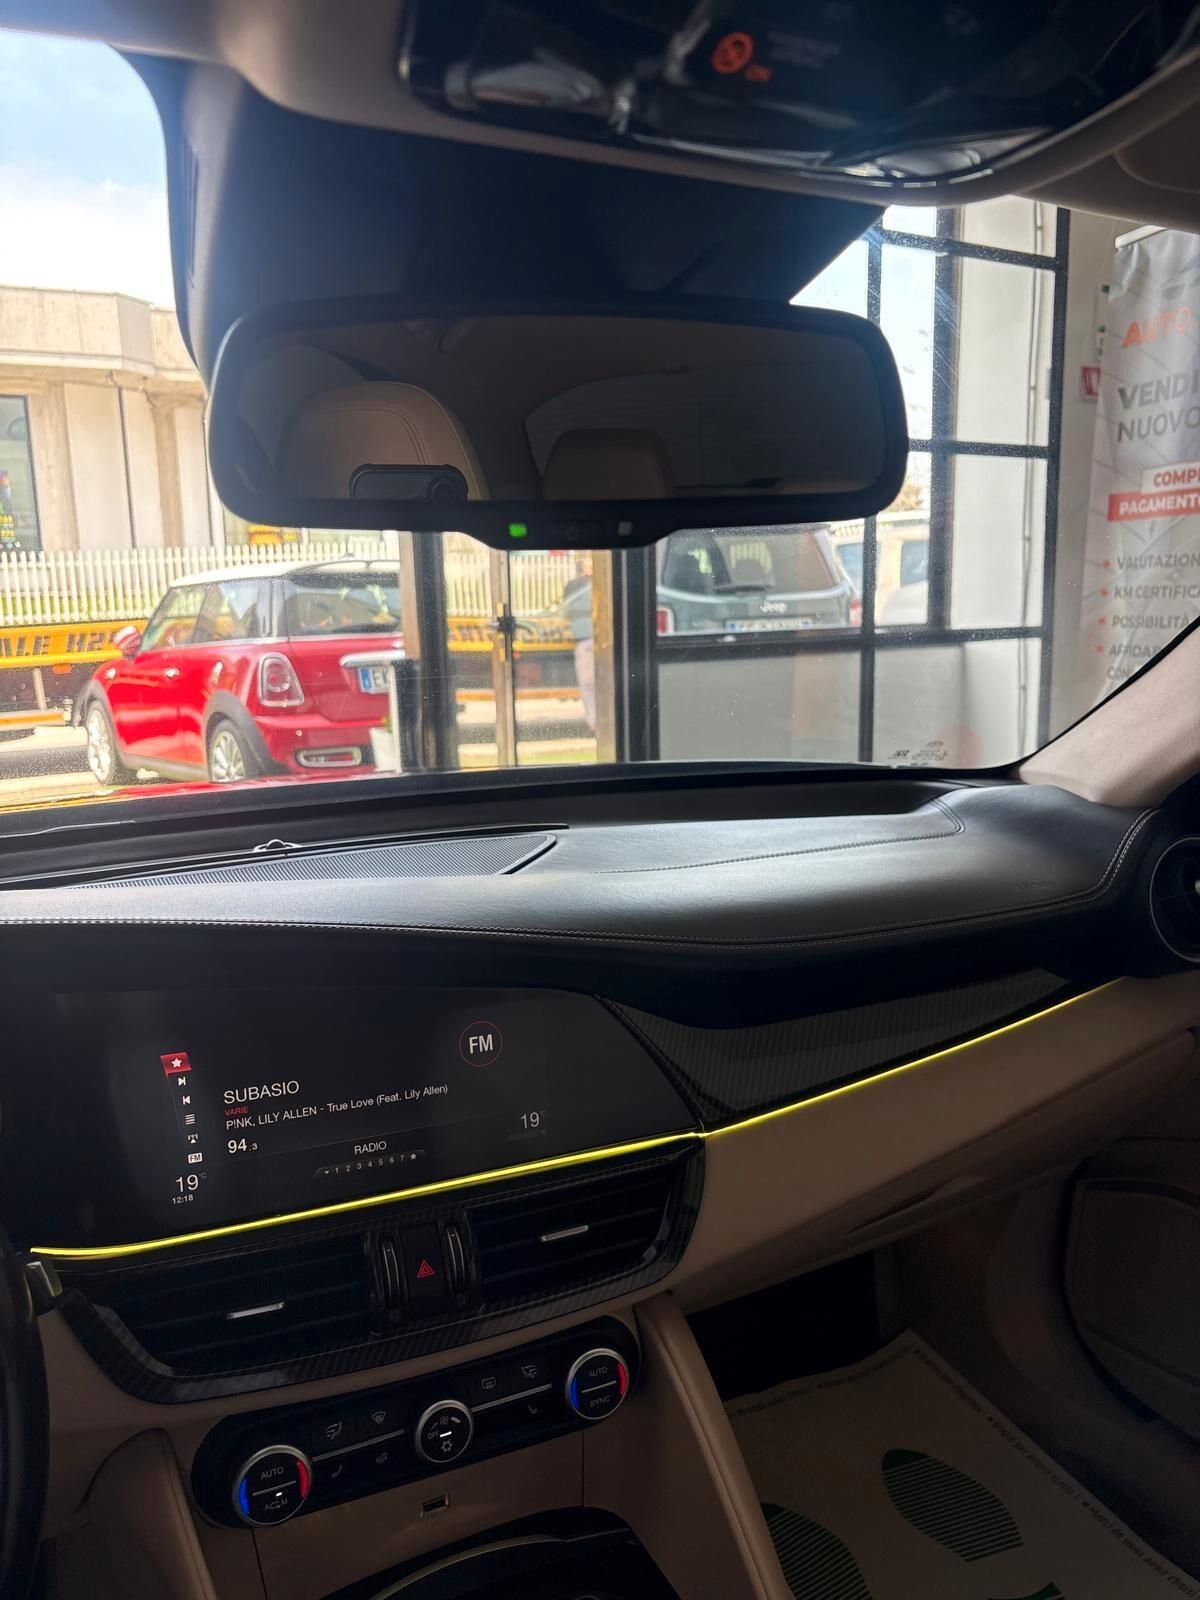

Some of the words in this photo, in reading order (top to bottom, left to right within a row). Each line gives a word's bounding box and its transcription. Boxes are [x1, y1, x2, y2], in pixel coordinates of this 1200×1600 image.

[1121, 304, 1192, 348] AUTO
[1117, 406, 1200, 443] NUOVO
[1153, 467, 1200, 488] COMP
[469, 1033, 494, 1054] FM
[223, 1080, 300, 1104] SUBASIO
[224, 1106, 249, 1116] VARIE
[258, 1112, 280, 1125] LILY
[282, 1106, 318, 1121] ALLEN
[327, 1102, 348, 1113] True
[350, 1096, 374, 1109] Love
[376, 1092, 402, 1107] (Feat.
[404, 1087, 421, 1101] Lily
[422, 1083, 448, 1096] Allen)
[354, 1140, 387, 1156] RADIO
[190, 1153, 202, 1163] FM
[172, 1194, 194, 1205] 12:18
[588, 1366, 608, 1378] AUTO
[589, 1394, 611, 1408] SYNC
[427, 1430, 440, 1440] OFF
[260, 1466, 284, 1480] AUTO
